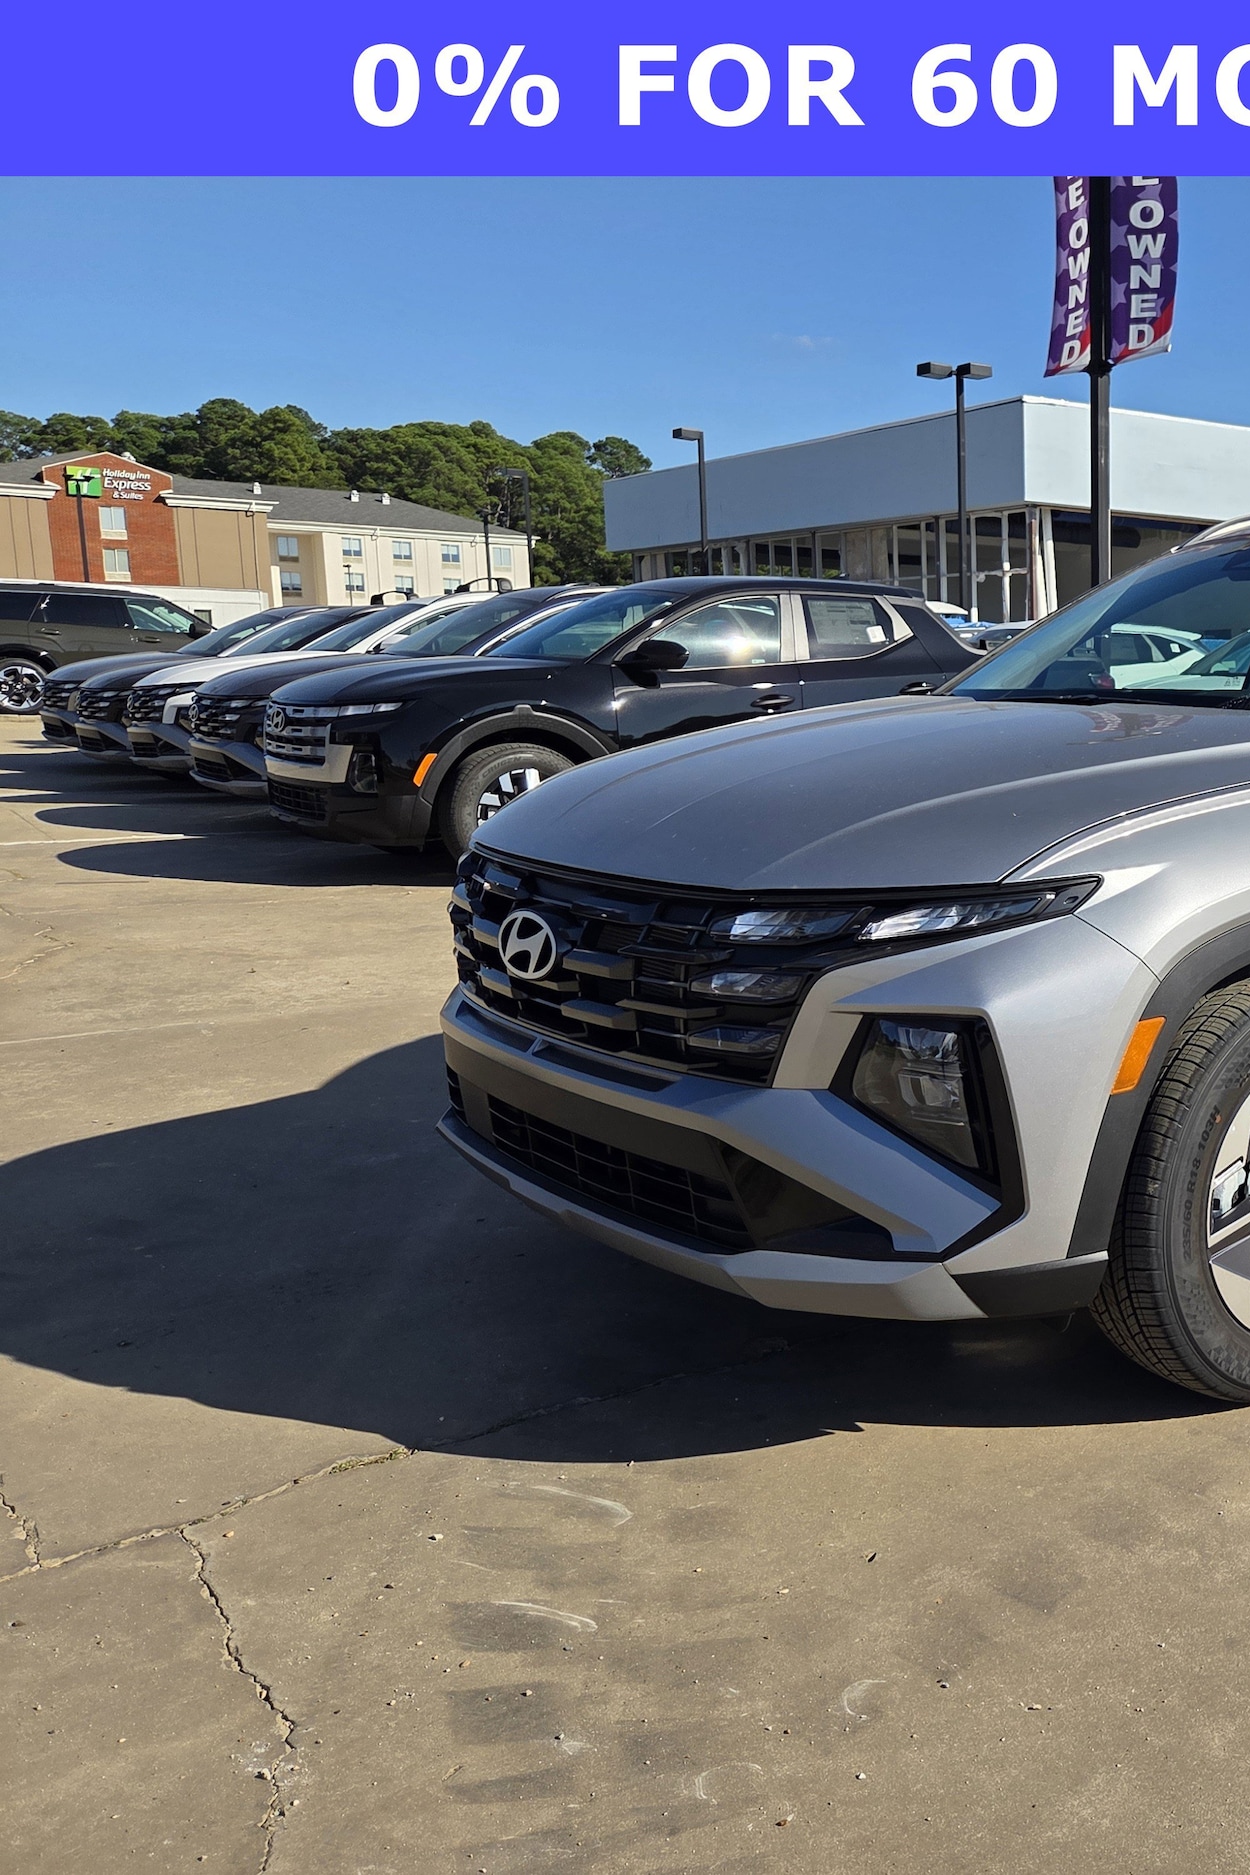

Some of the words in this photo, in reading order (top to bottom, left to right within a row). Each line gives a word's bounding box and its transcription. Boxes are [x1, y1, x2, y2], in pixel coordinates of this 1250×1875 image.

[1127, 199, 1166, 350] OWNED
[1060, 217, 1090, 367] OWNED
[103, 468, 136, 481] Holiday
[136, 471, 151, 480] Inn
[104, 477, 151, 491] Express
[112, 491, 119, 499] &
[120, 491, 144, 500] Suites
